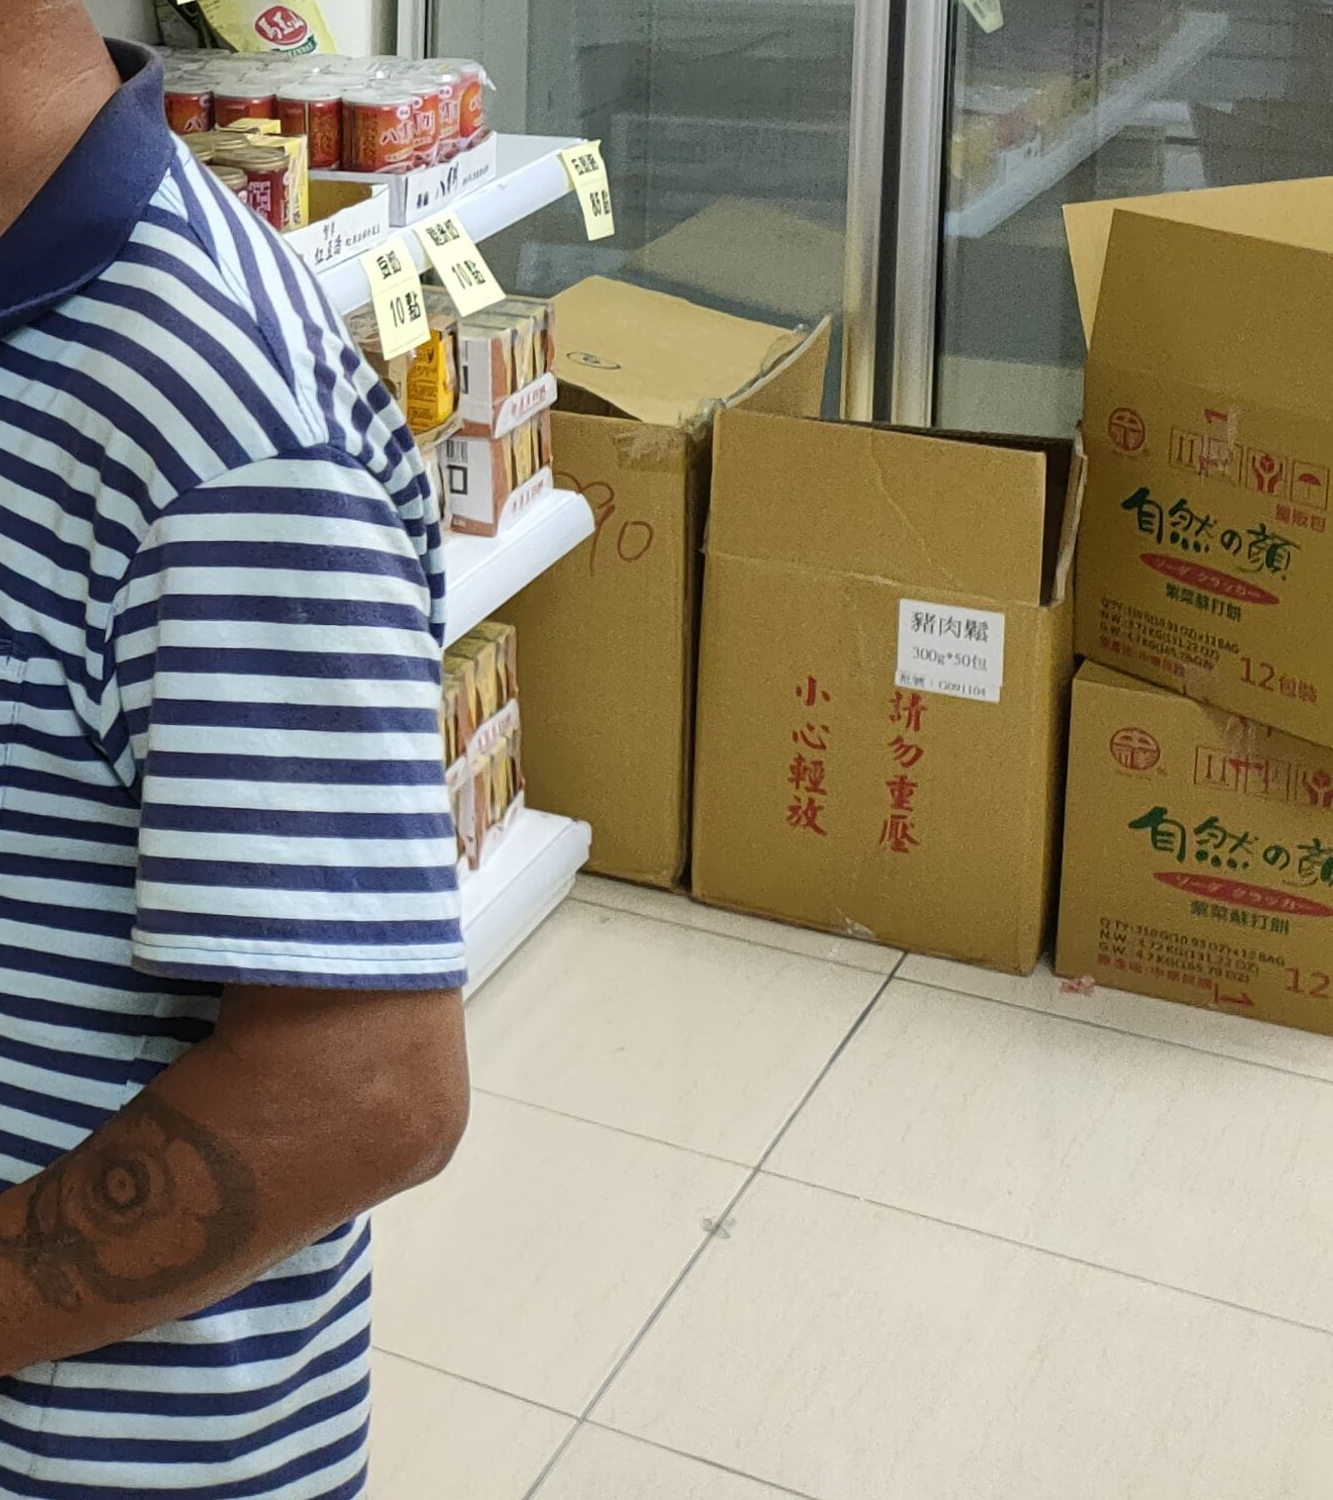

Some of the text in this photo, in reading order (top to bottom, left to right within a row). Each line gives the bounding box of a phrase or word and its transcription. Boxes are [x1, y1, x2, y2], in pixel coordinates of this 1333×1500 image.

[389, 296, 406, 328] 10
[1121, 486, 1301, 582] 自然の顔
[911, 611, 989, 643] 豬肉鬆
[785, 675, 831, 836] 小心輕放
[879, 690, 929, 853] 請勿重壓
